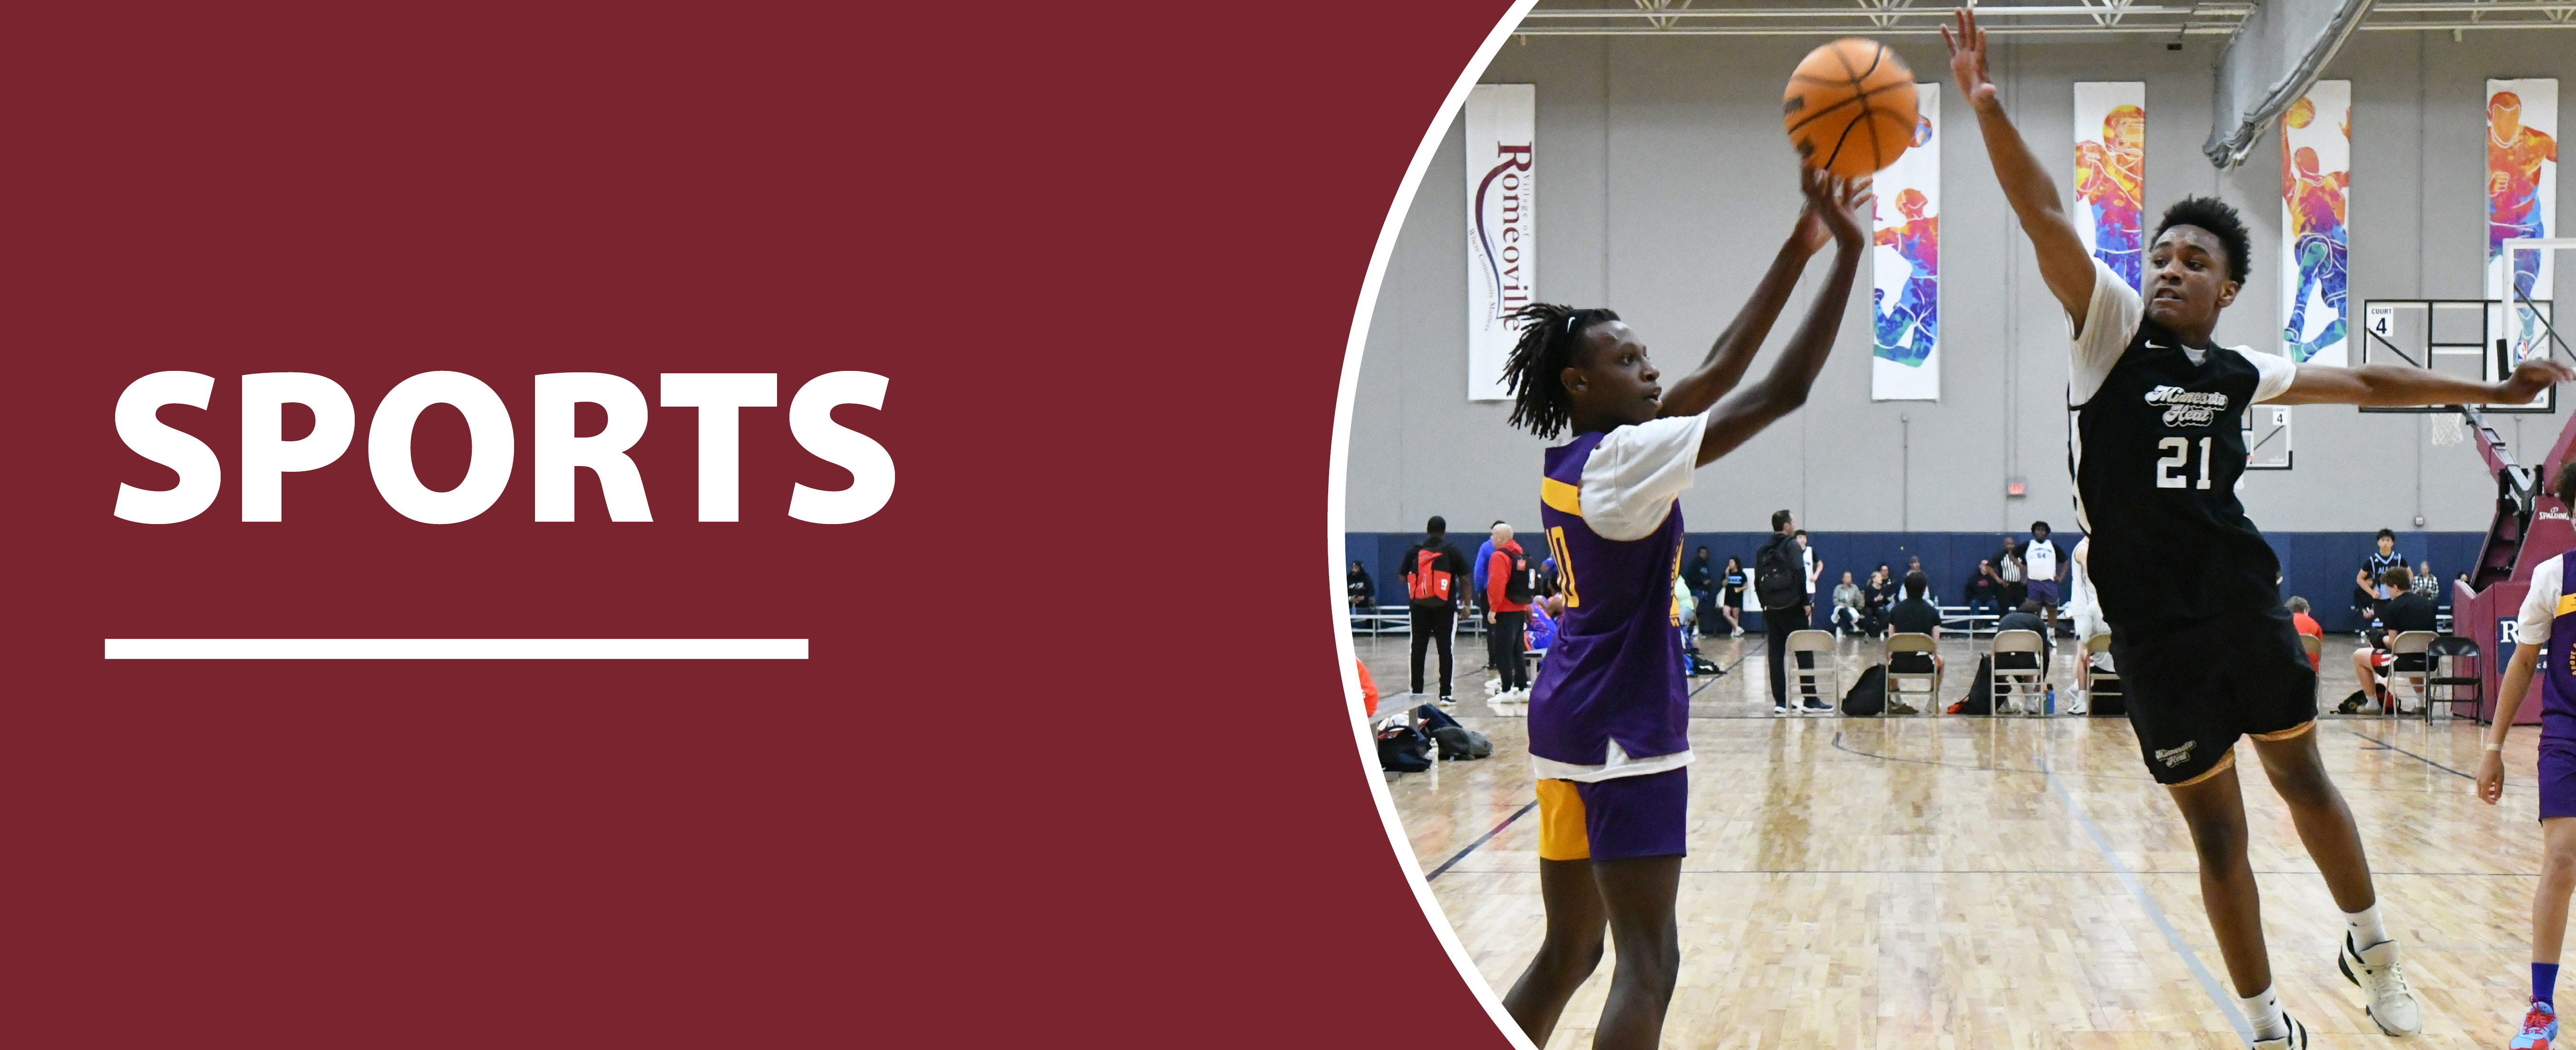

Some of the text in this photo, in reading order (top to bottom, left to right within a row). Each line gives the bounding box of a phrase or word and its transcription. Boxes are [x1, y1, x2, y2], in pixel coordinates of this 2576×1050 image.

[1522, 175, 1530, 237] Village of
[1498, 141, 1532, 331] Romeoville
[1469, 228, 1496, 331] Where Community Matters
[2376, 317, 2387, 334] 4
[2145, 385, 2228, 411] Minnesota
[2162, 404, 2214, 427] Heat
[2277, 413, 2283, 423] 4
[2157, 437, 2212, 489] 21
[2539, 511, 2570, 521] SPALDING
[1441, 578, 1448, 591] 9
